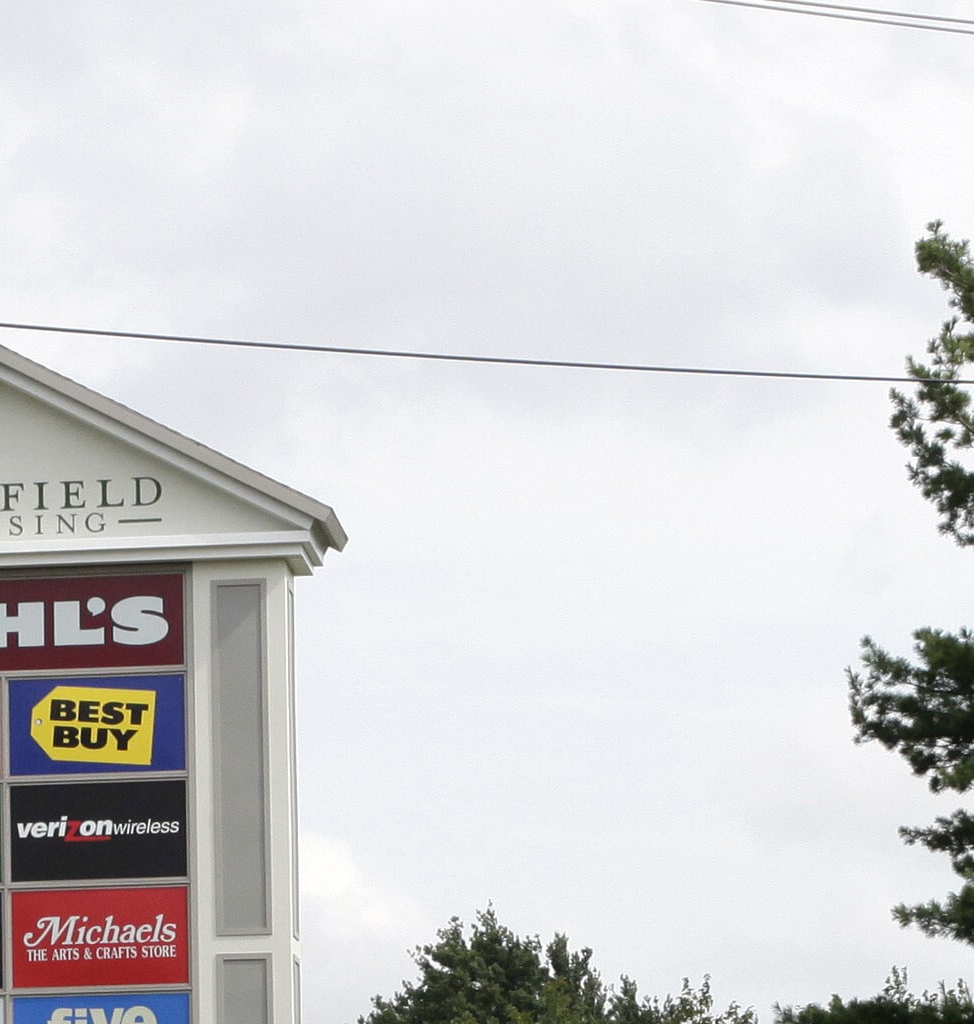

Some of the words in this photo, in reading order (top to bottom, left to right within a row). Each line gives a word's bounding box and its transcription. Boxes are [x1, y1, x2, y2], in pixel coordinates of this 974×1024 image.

[49, 699, 149, 726] BEST
[52, 725, 139, 751] BUY
[22, 913, 177, 947] Michaels
[27, 948, 49, 962] THE
[52, 947, 80, 961] ARTS
[83, 947, 93, 961] &
[95, 946, 138, 960] CRAFTS
[141, 945, 177, 958] STORE
